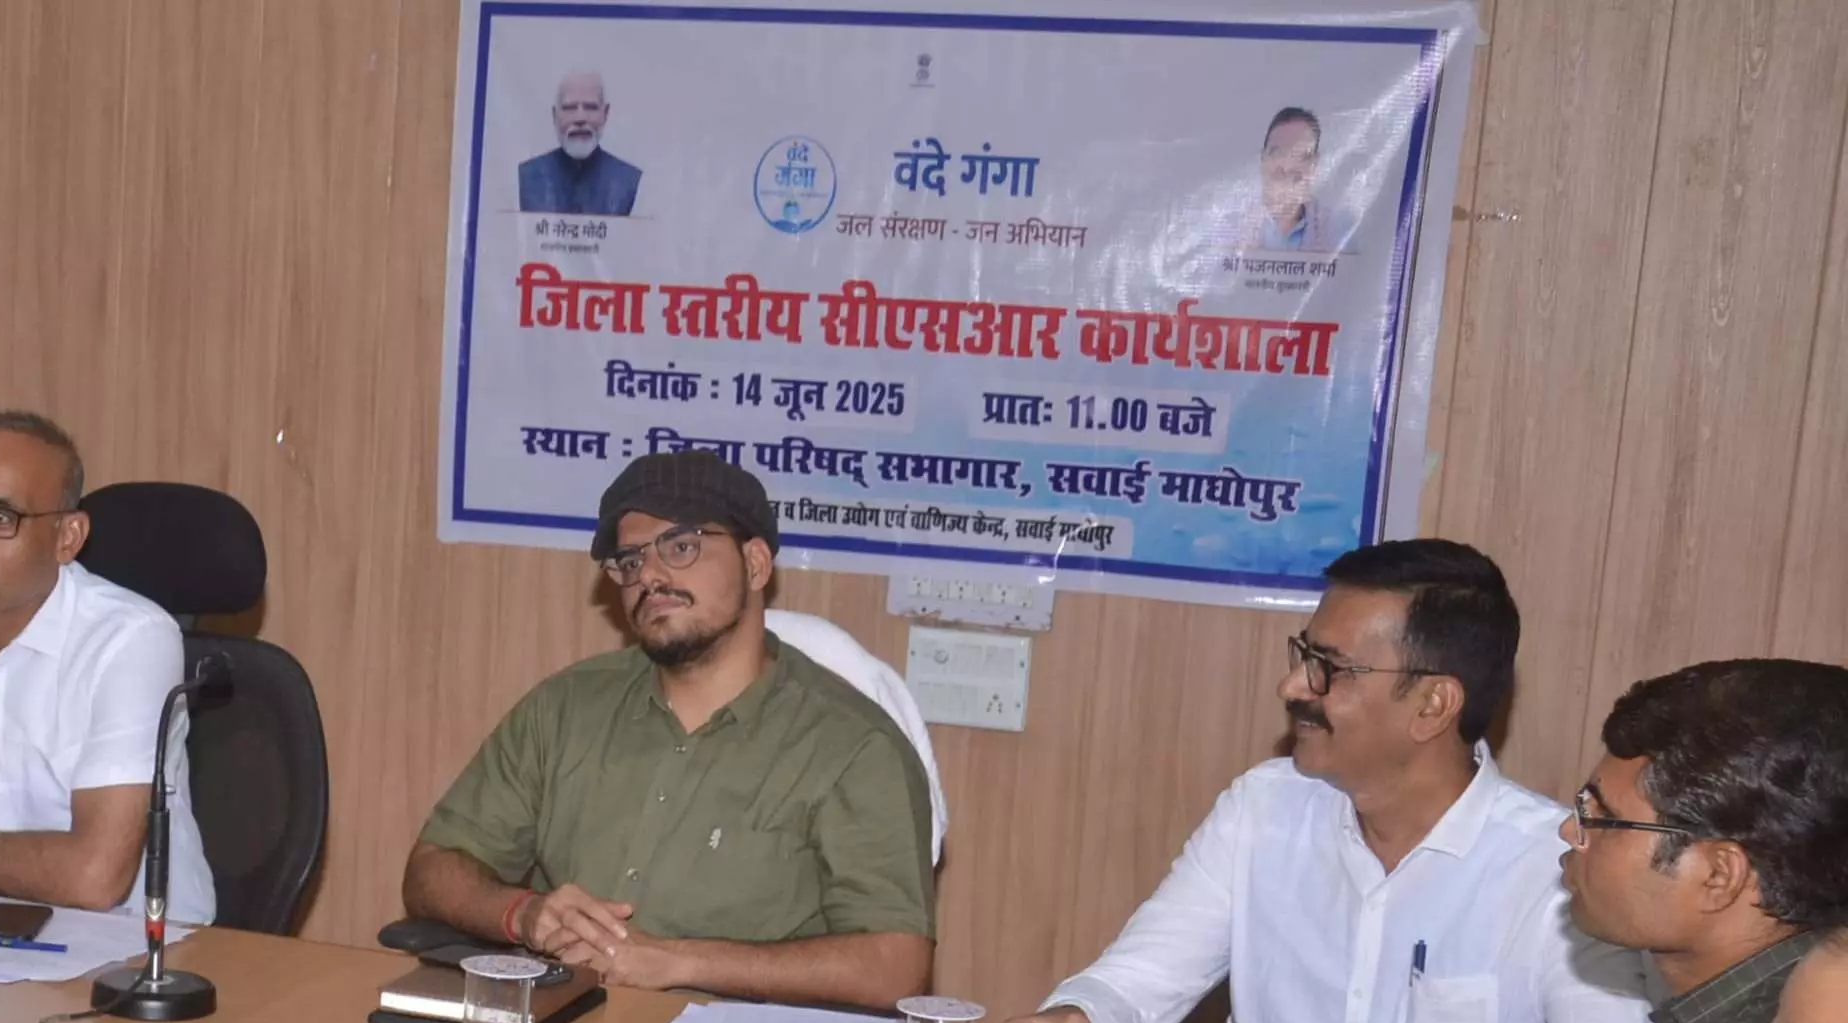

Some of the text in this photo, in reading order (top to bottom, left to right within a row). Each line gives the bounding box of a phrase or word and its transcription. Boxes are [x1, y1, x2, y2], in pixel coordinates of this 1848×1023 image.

[894, 137, 1040, 197] वंदे गंगा
[582, 219, 608, 240] मोदी
[836, 213, 874, 239] जल
[881, 211, 947, 241] संरक्षण
[966, 220, 1000, 244] जन
[1006, 217, 1088, 248] अभियान
[515, 262, 1340, 377] जिला स्तरीय सीएसआर कार्यशाला
[604, 359, 701, 401] दिनांक
[732, 373, 762, 406] 14
[771, 377, 828, 420] जून
[835, 379, 905, 416] 2025
[982, 392, 1052, 426] प्रातः
[1066, 395, 1148, 433] 11.00
[1157, 396, 1217, 438] बजे
[520, 426, 610, 460] स्थान
[753, 436, 869, 489] परिषद्
[875, 452, 1031, 497] सभागार,
[1046, 460, 1151, 502] सवाई
[799, 497, 838, 524] जिला
[1015, 514, 1057, 542] सवाई
